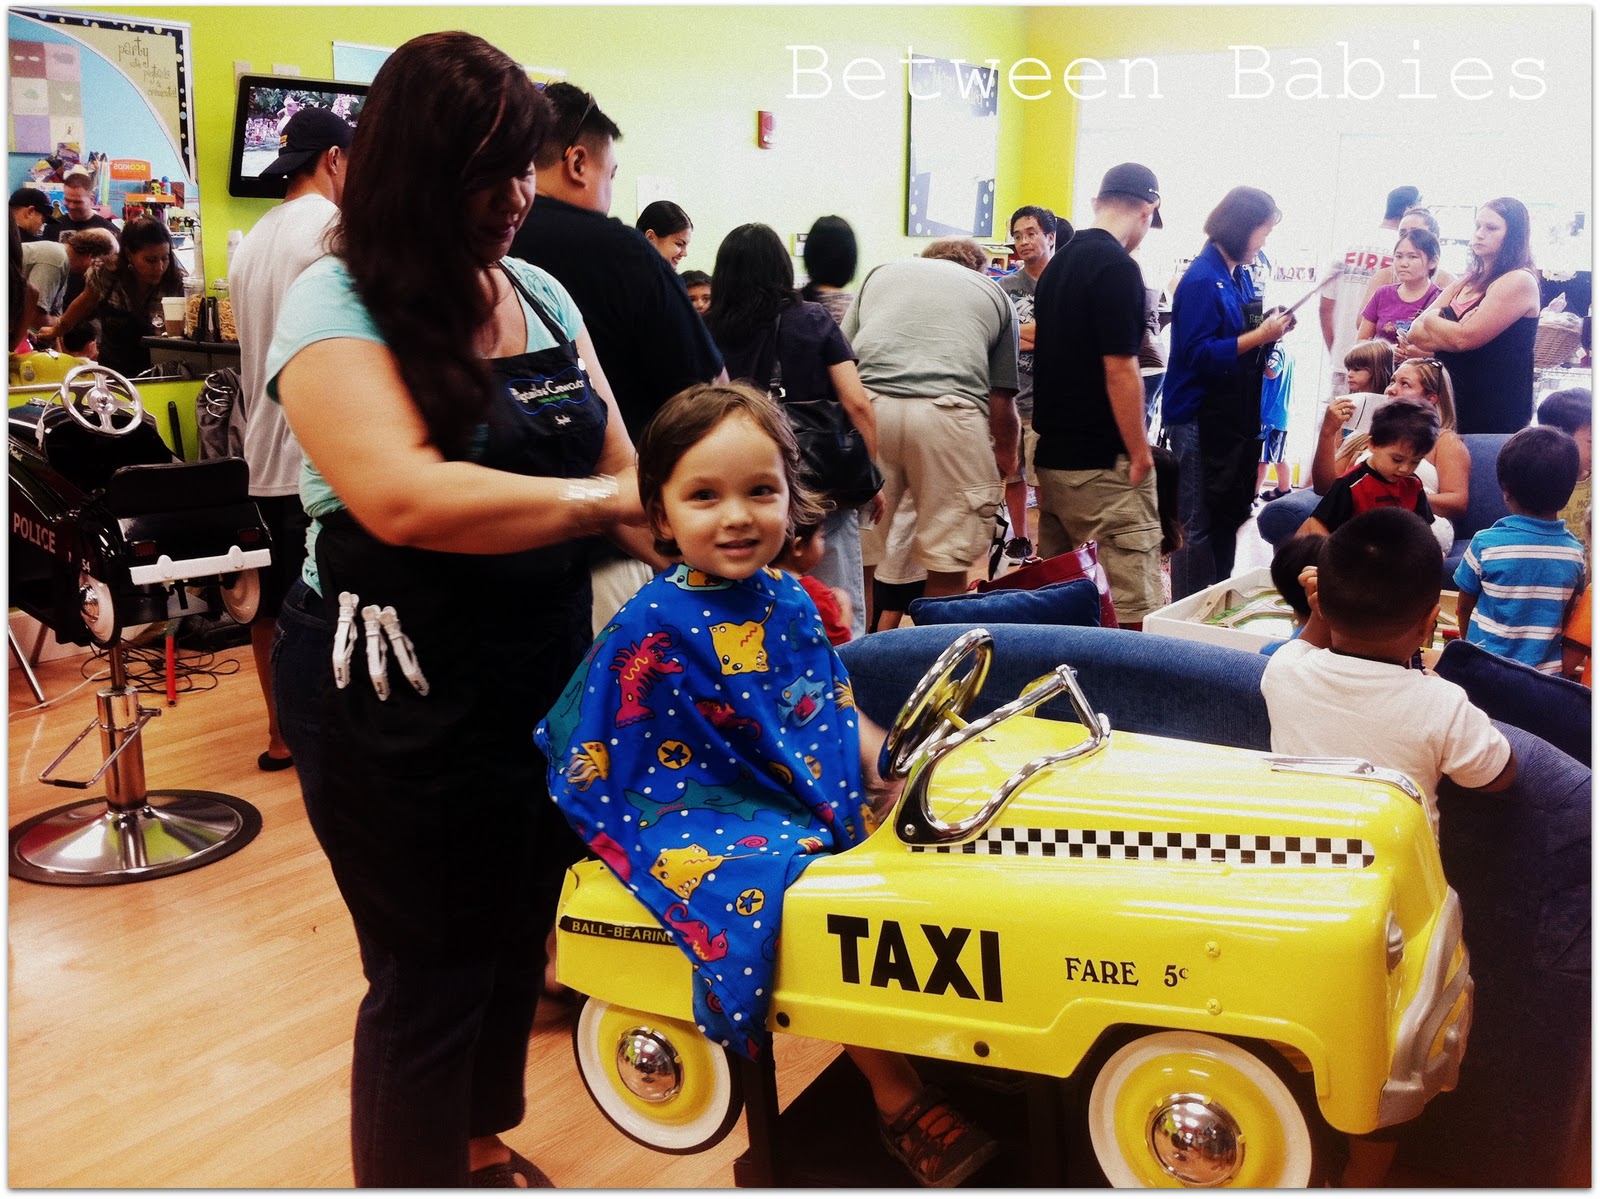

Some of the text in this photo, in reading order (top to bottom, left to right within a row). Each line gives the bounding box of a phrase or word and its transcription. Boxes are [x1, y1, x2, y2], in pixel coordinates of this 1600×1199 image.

[118, 36, 149, 68] party
[13, 512, 56, 554] POLICE
[81, 558, 91, 573] 54
[827, 913, 1003, 1002] TAXI
[1064, 957, 1139, 986] FARE
